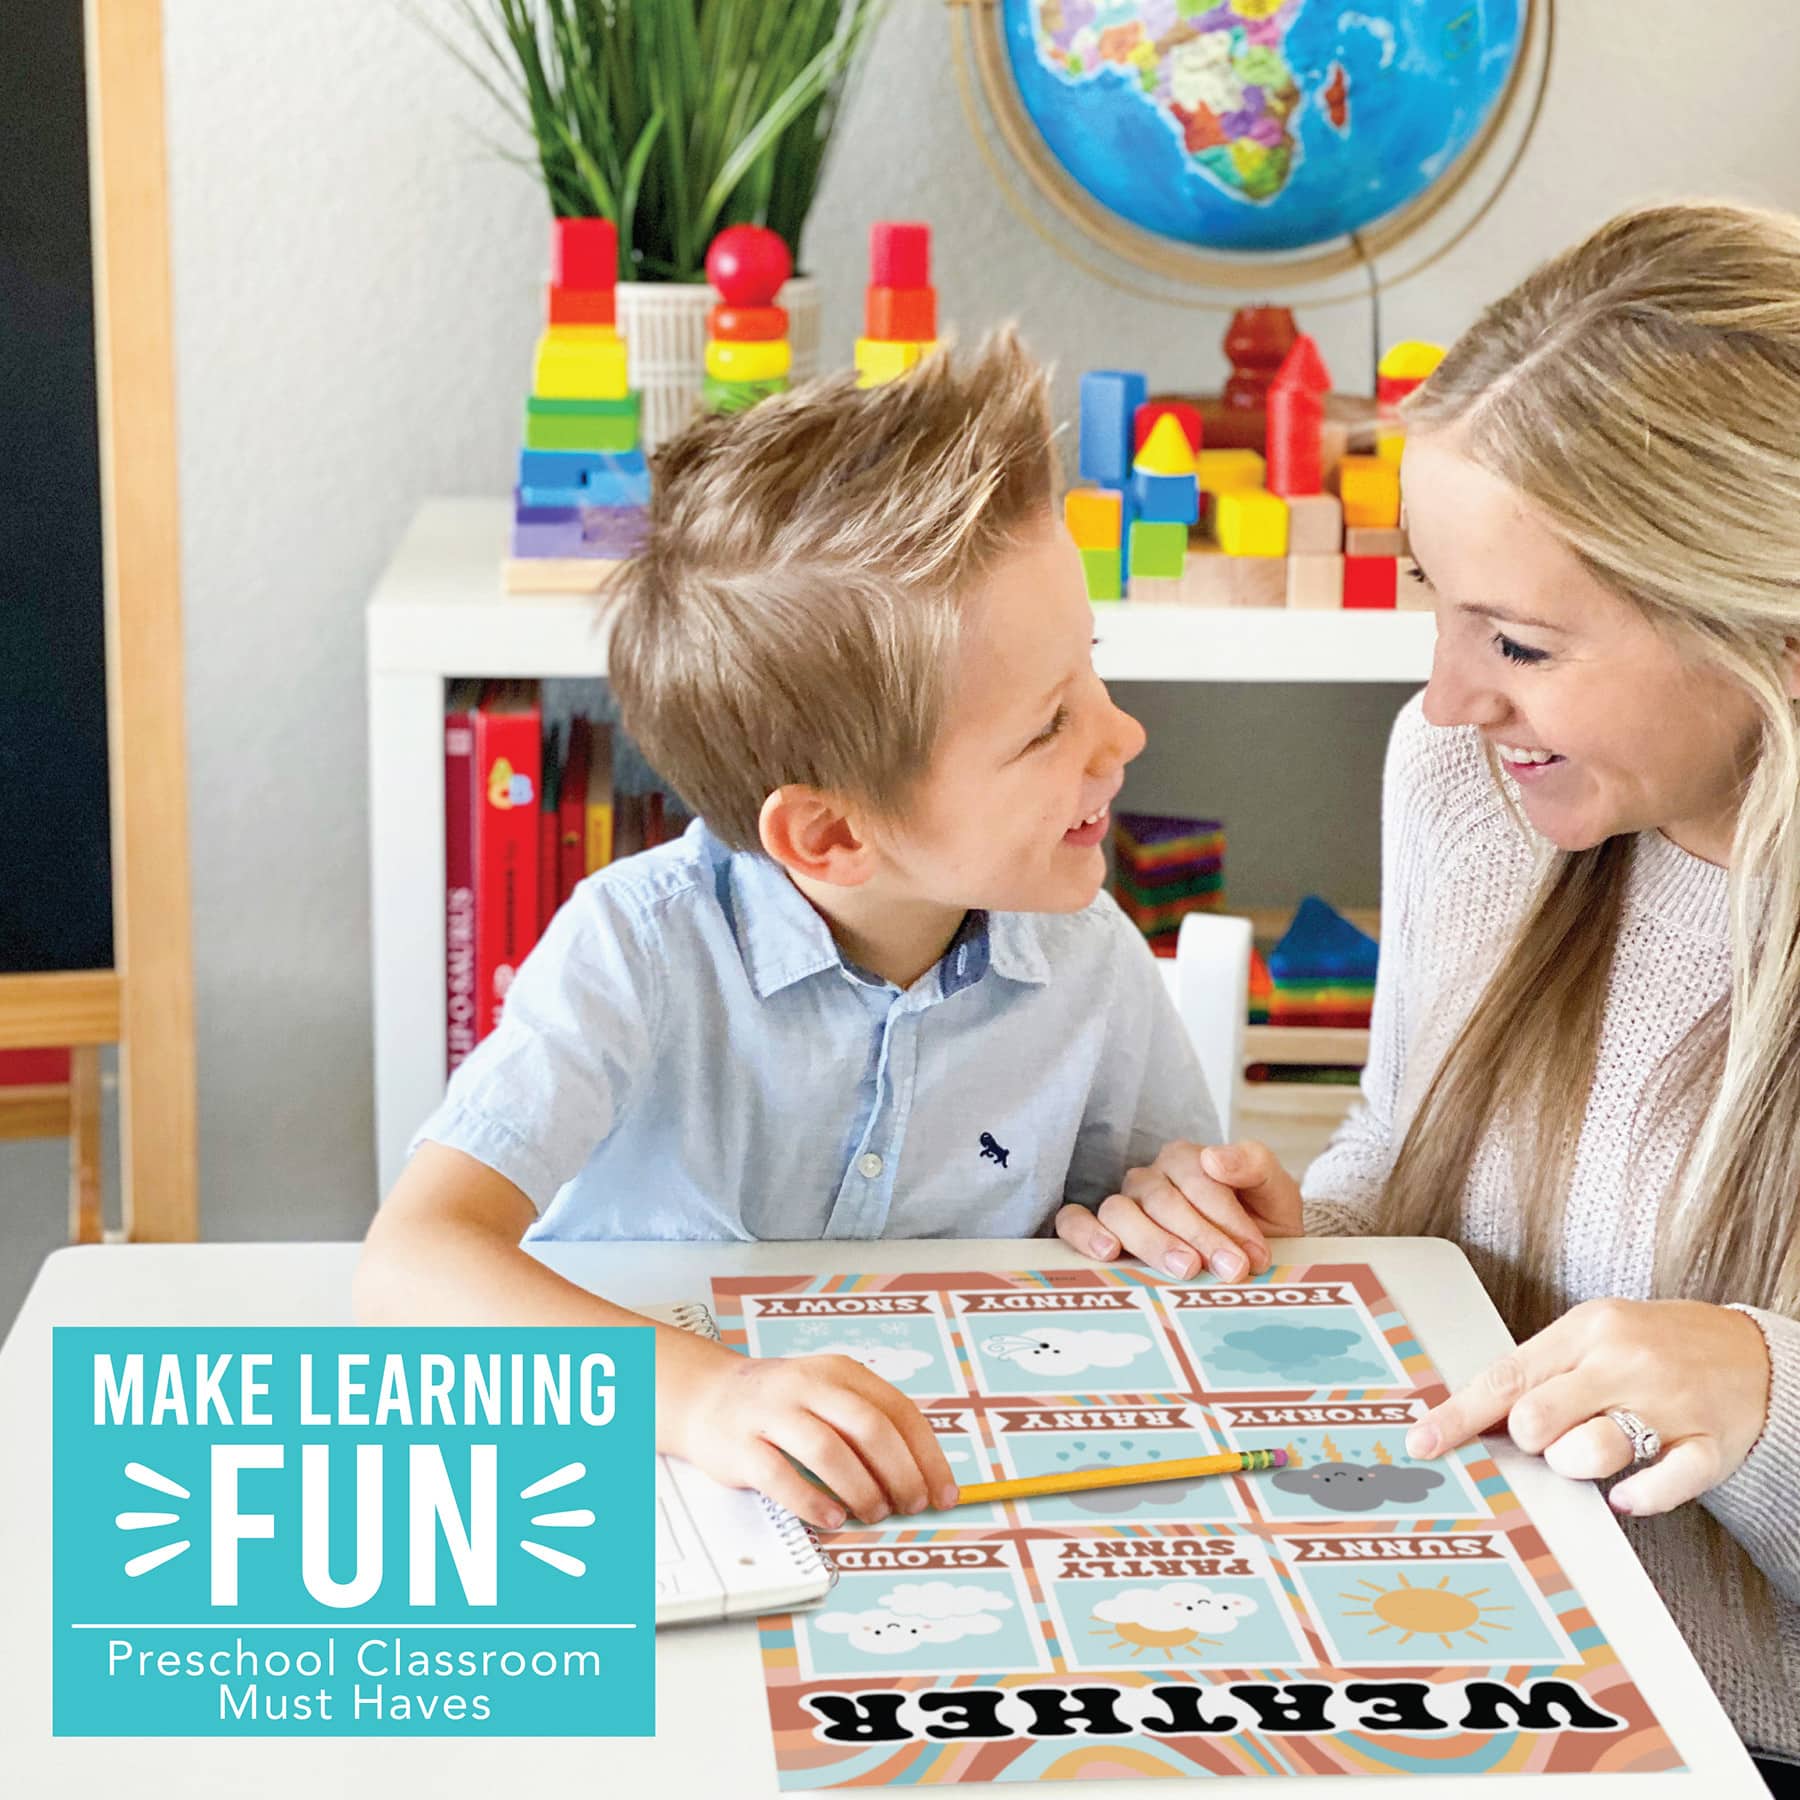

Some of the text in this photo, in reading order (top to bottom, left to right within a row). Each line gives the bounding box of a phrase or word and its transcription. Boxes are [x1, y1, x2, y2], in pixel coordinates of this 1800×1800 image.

[765, 1298, 920, 1315] SNOWY
[977, 1293, 1123, 1310] WINDY
[1185, 1288, 1339, 1307] FOGGY
[1020, 1411, 1175, 1429] RAINY
[1236, 1406, 1407, 1424] STORMY
[1058, 1539, 1236, 1558] SUNNY
[1300, 1538, 1490, 1558] SUNNY
[835, 1548, 988, 1568] CLOUD
[1058, 1559, 1256, 1579] PARTLY
[810, 1682, 1618, 1742] WEATHER
